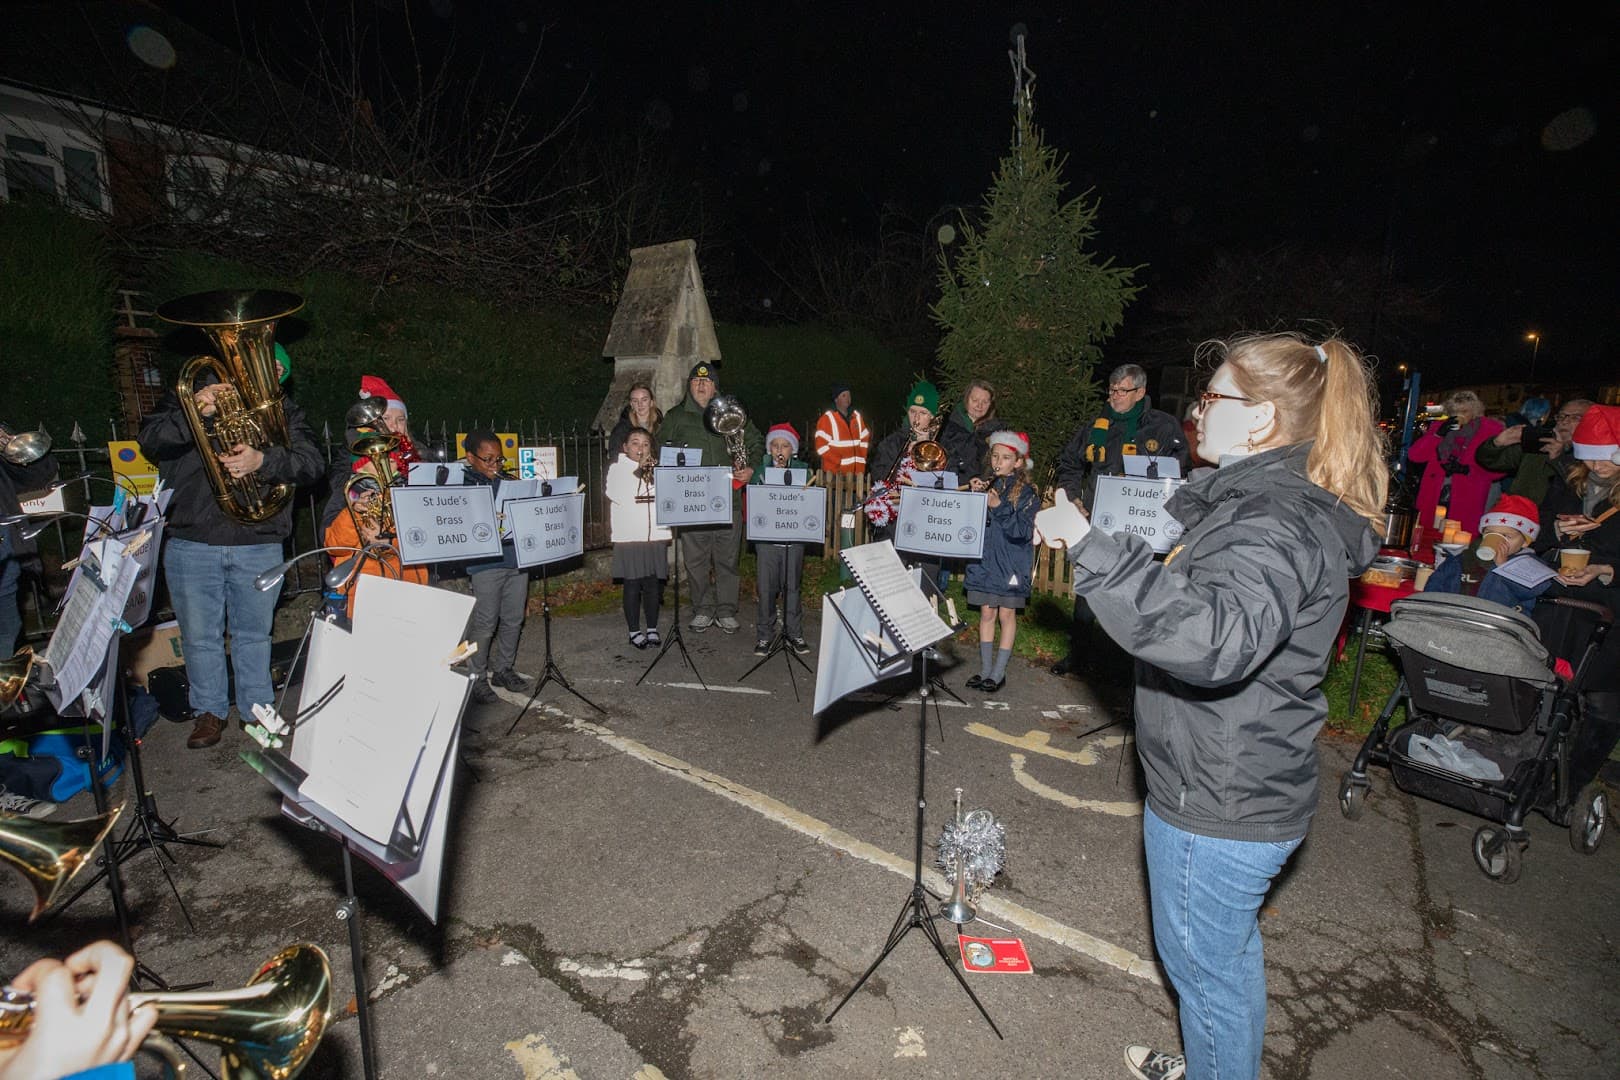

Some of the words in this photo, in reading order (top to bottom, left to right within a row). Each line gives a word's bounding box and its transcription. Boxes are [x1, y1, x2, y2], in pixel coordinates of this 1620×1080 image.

[676, 474, 684, 483] St
[684, 489, 705, 498] Brass
[1121, 486, 1131, 496] St
[422, 496, 434, 507] St
[769, 492, 777, 501] St
[921, 497, 930, 506] St
[22, 499, 45, 507] only
[534, 506, 544, 516] St
[683, 504, 706, 513] BAND
[776, 507, 798, 516] Brass
[1128, 505, 1157, 518] Brass
[436, 515, 463, 525] Brass
[775, 521, 799, 529] BAND
[927, 514, 953, 526] Brass
[545, 522, 565, 532] Brass
[1124, 524, 1156, 537] BAND
[437, 533, 468, 545] BAND
[924, 531, 952, 543] BAND
[545, 537, 566, 549] BAND
